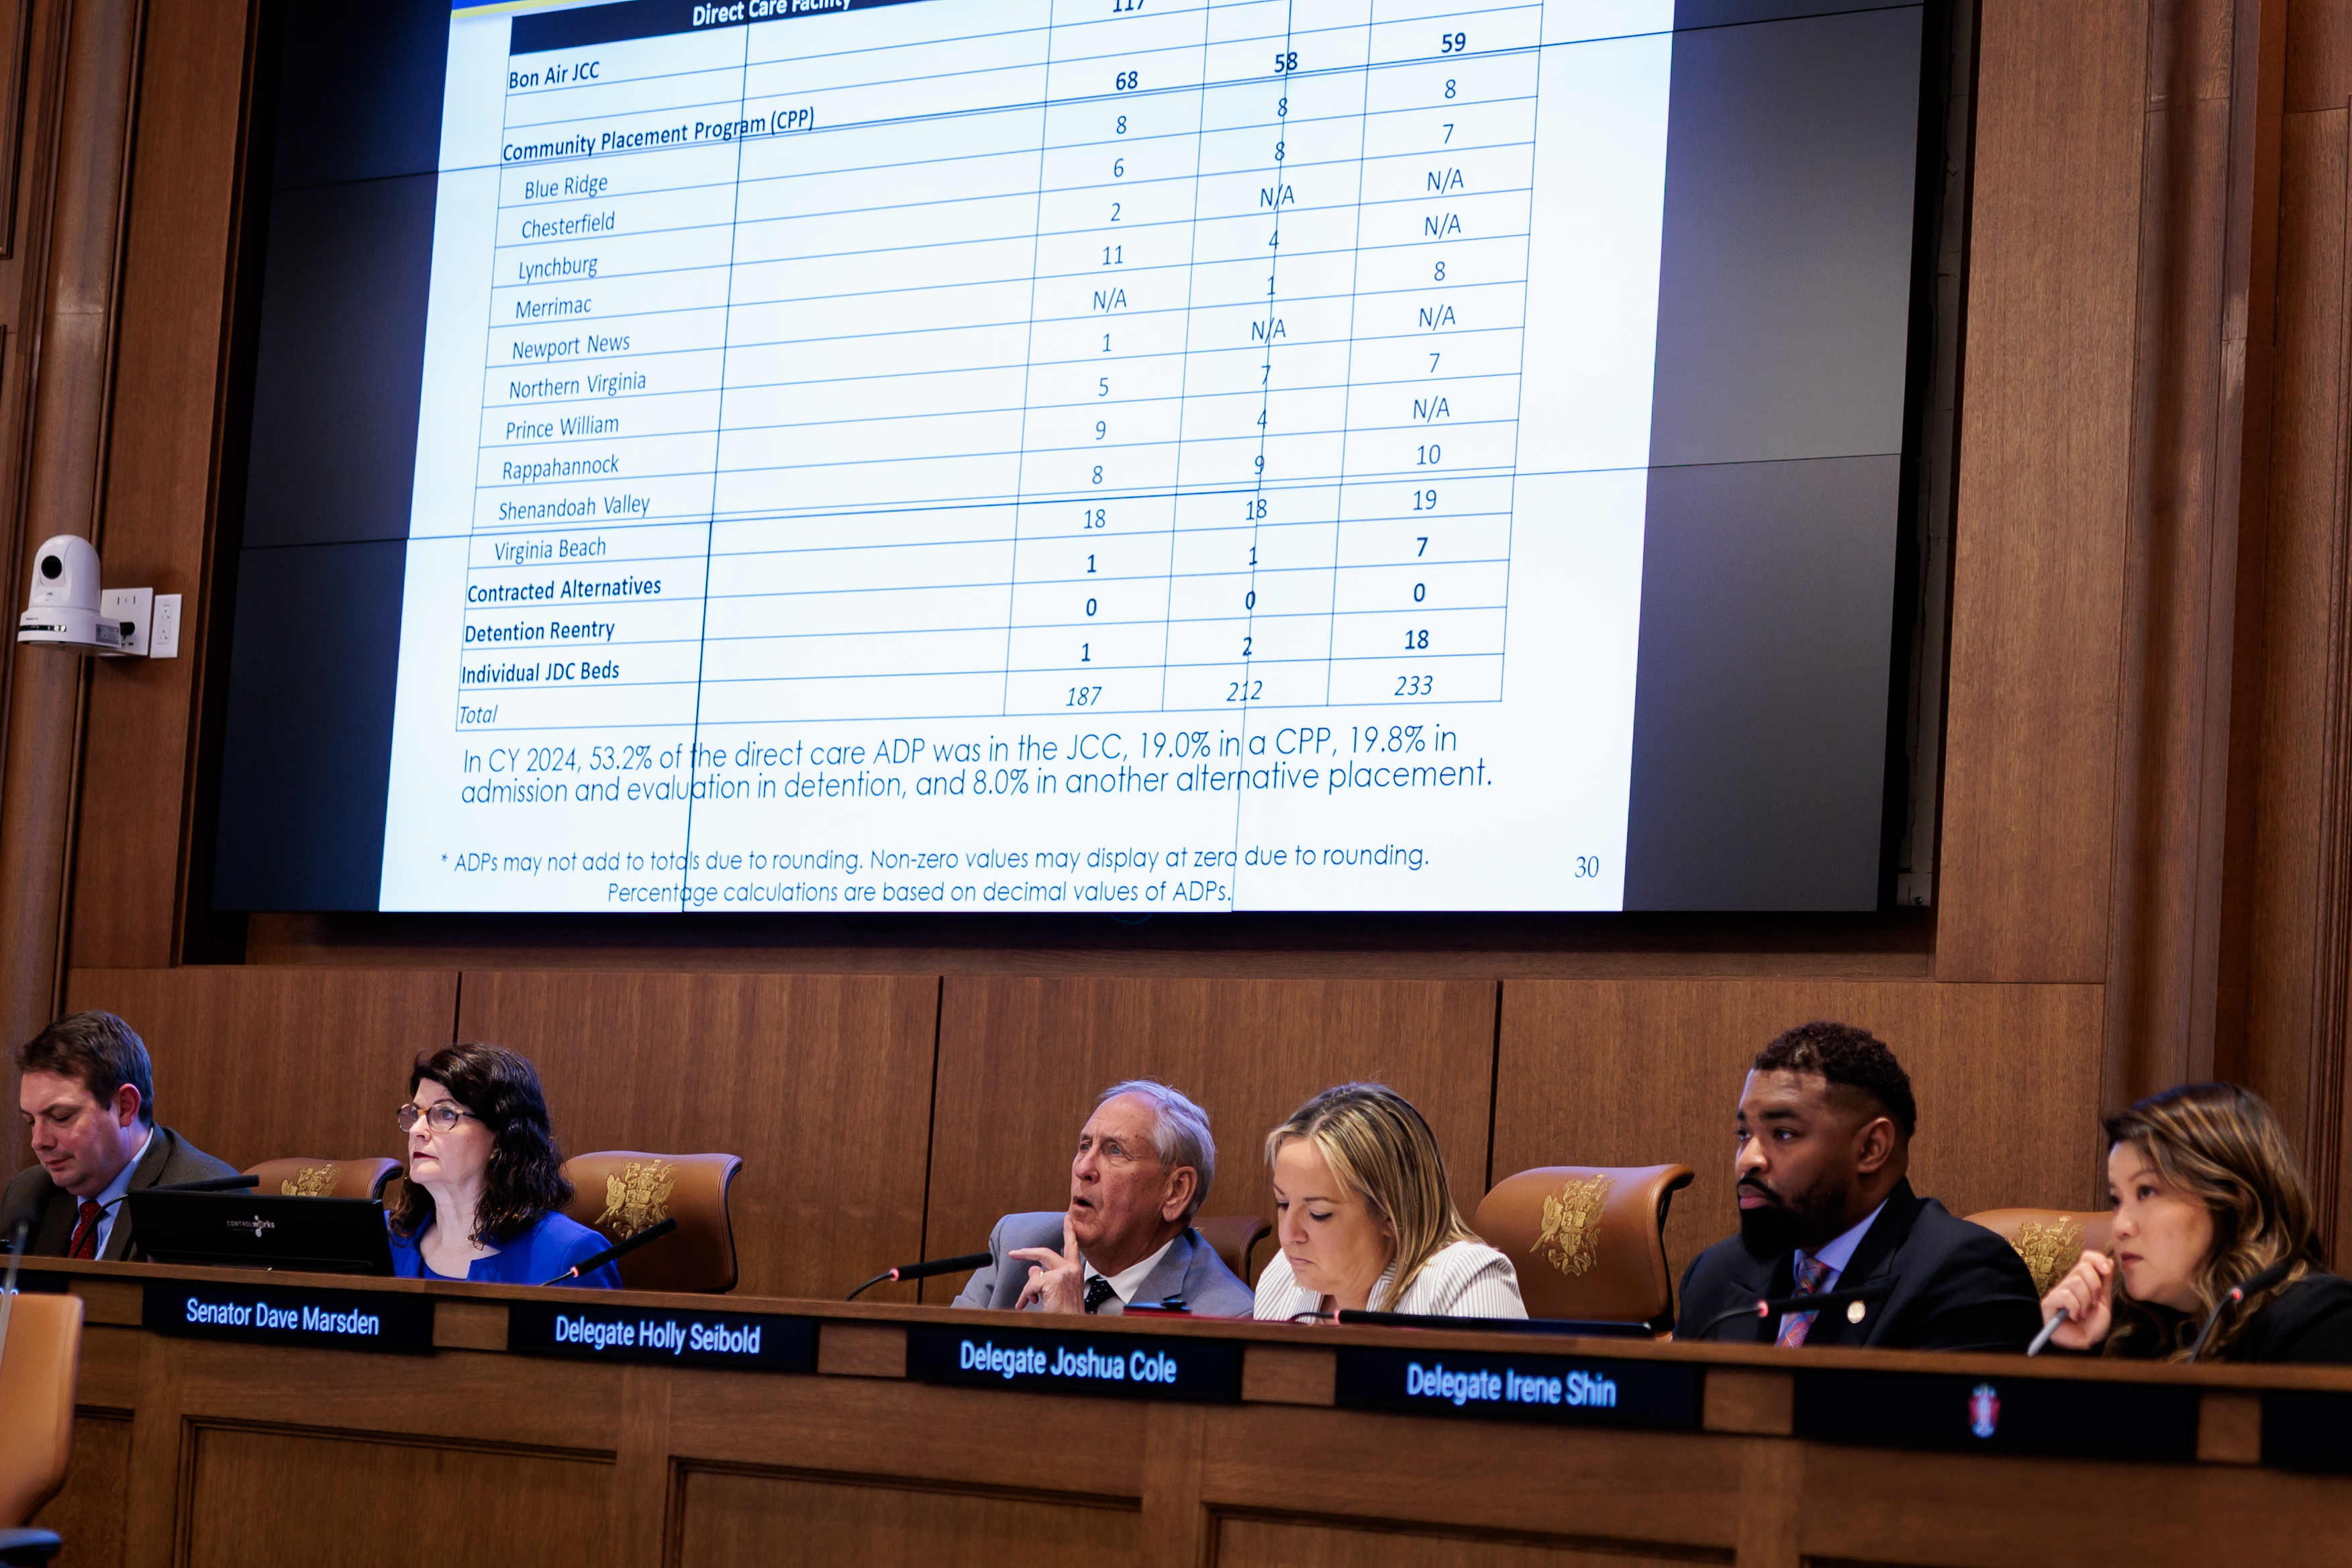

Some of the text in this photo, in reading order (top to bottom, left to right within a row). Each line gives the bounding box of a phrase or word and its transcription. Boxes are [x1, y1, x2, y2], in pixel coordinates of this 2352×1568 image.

[693, 3, 744, 26] Direct
[749, 1, 787, 17] Care
[1441, 33, 1466, 53] 59
[1275, 52, 1297, 72] 58
[509, 62, 599, 89] Bon Air JCC
[1116, 71, 1138, 91] 68
[1445, 79, 1456, 98] 8
[1277, 98, 1287, 117] 8
[503, 107, 814, 161] Community Placement Program (CPP)
[1116, 115, 1126, 134] 8
[1443, 125, 1453, 144] 7
[1275, 142, 1285, 161] 8
[1114, 158, 1124, 177] 6
[526, 175, 607, 199] Blue Ridge
[1428, 168, 1463, 194] N/A
[1261, 185, 1295, 210] N/A
[1111, 203, 1121, 222] 2
[522, 212, 615, 239] Chesterfield
[1425, 213, 1461, 239] N/A
[1269, 230, 1279, 249] 4
[1103, 246, 1124, 265] 11
[519, 256, 598, 281] Lynchburg
[1434, 262, 1445, 281] 8
[1267, 276, 1275, 295] 1
[516, 297, 591, 319] Merrimac
[1093, 288, 1126, 313] N/A
[1419, 305, 1456, 331] N/A
[1252, 318, 1286, 344] N/A
[513, 335, 630, 362] Newport News
[1103, 334, 1112, 352] 1
[1429, 352, 1440, 373] 7
[510, 371, 646, 399] Northern Virginia
[1261, 365, 1271, 385] 7
[1099, 378, 1108, 397] 5
[1257, 409, 1267, 429] 4
[1413, 396, 1451, 423] N/A
[506, 416, 619, 440] Prince William
[1096, 421, 1106, 440] 9
[1255, 455, 1265, 475] 9
[1416, 444, 1441, 466] 10
[503, 454, 619, 484] Rappahannock
[1093, 466, 1103, 485] 8
[499, 494, 650, 520] Shenandoah Valley
[1246, 499, 1267, 520] 18
[1413, 490, 1437, 511] 19
[1083, 509, 1106, 529] 18
[495, 536, 606, 564] Virginia Beach
[1248, 546, 1258, 566] 1
[1416, 537, 1428, 557] 7
[1087, 555, 1096, 573] 1
[469, 577, 661, 602] Contracted Alternatives
[1414, 583, 1426, 603] 0
[1086, 598, 1097, 616] 0
[1246, 591, 1257, 611] 0
[466, 620, 615, 642] Detention Reentry
[1405, 630, 1430, 650] 18
[1082, 643, 1091, 662] 1
[1242, 636, 1253, 657] 2
[462, 660, 619, 685] Individual JDC Beds
[1226, 681, 1263, 702] 212
[1395, 675, 1433, 697] 233
[1067, 687, 1102, 707] 187
[459, 704, 498, 724] Total
[464, 724, 1457, 773] In CY 2024, 53.2% of the direct care ADP was in the JCC, 19.0% in a CPP, 19.8% in
[462, 758, 1492, 803] admission and evaluation in detention, and 8.0% in another alternative placement.
[455, 844, 1429, 876] ADPs may not add to totals due to rounding. Non-zero values may display at zero due to rounding.
[1575, 856, 1600, 878] 30
[608, 880, 1231, 907] Percentage calculations are based on decimal values of ADPs.
[186, 1297, 380, 1335] Senator Dave Marsden
[556, 1315, 761, 1355] Delegate Holly Seibold
[961, 1339, 1177, 1383] Delegate Joshua Cole
[1407, 1363, 1616, 1407] Delegate Irene Shin
